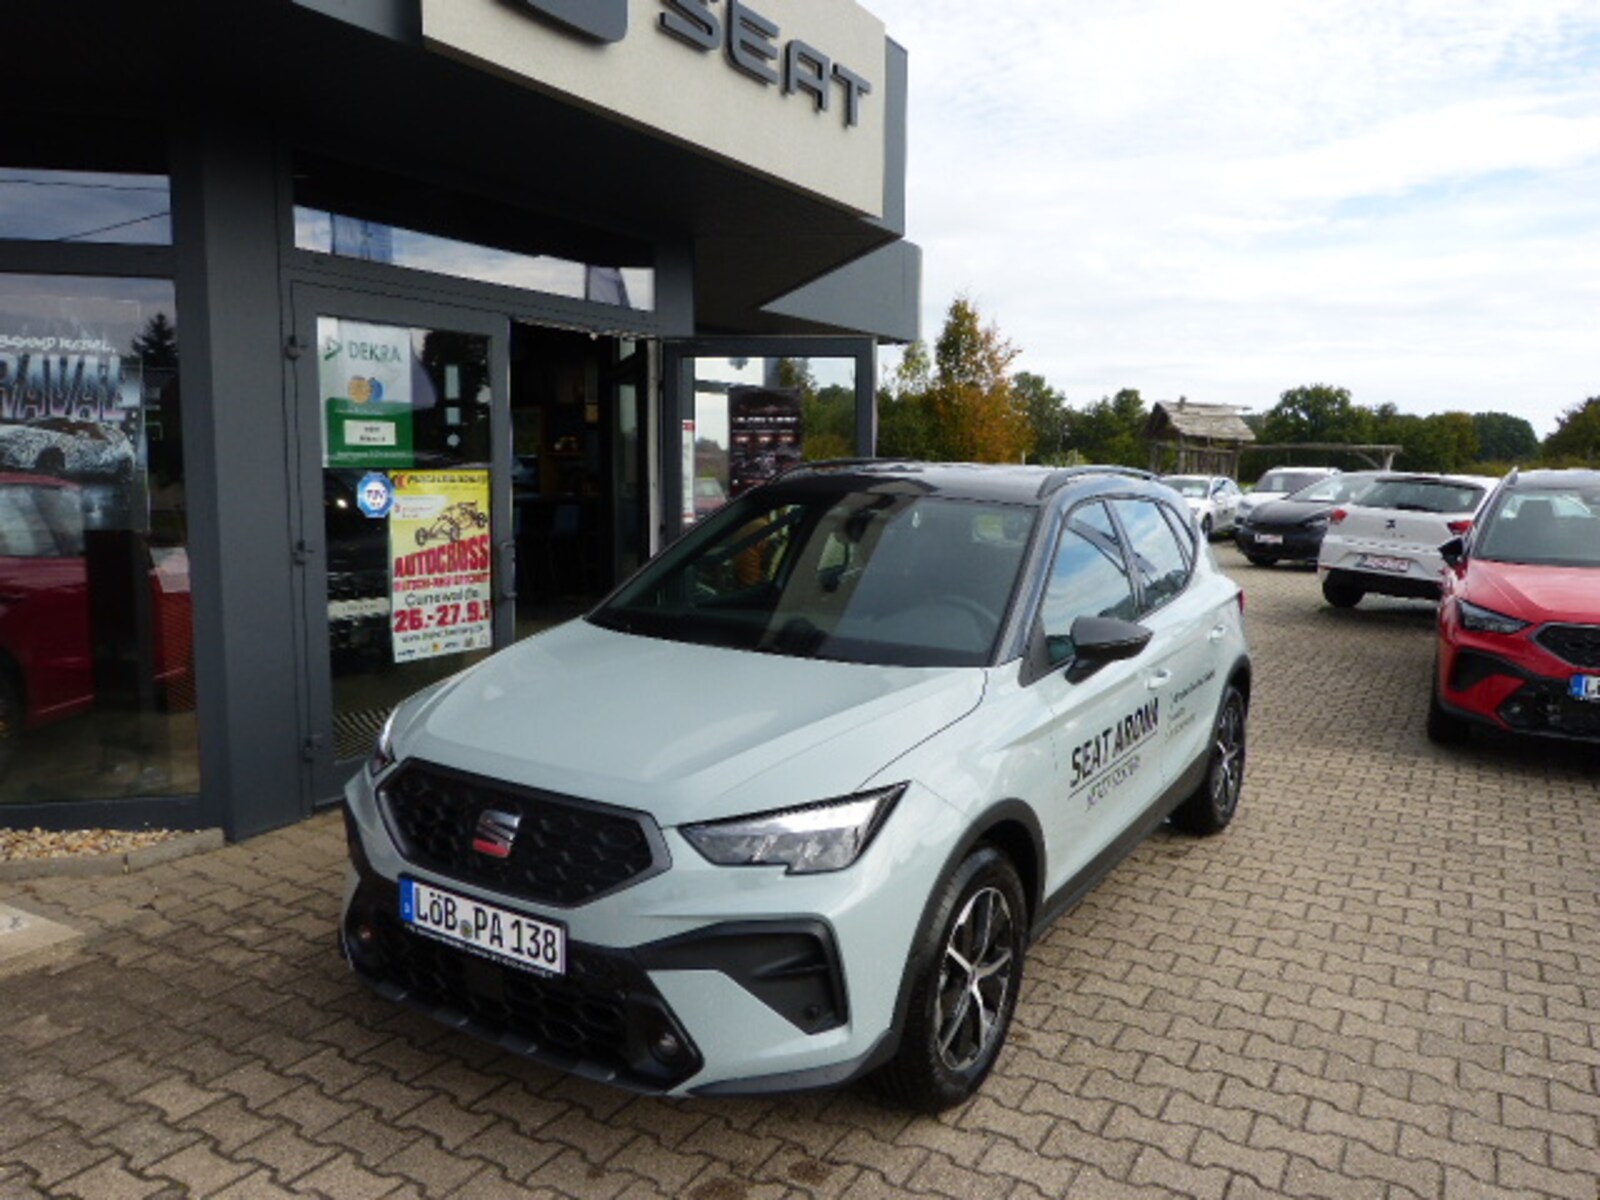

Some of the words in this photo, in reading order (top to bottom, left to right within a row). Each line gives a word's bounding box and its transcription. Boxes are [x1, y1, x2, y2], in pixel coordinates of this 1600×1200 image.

[656, 0, 872, 129] SEAT
[348, 340, 403, 363] DEKRA
[1069, 726, 1113, 789] SEAT
[472, 904, 505, 949] PA
[509, 919, 557, 964] 138
